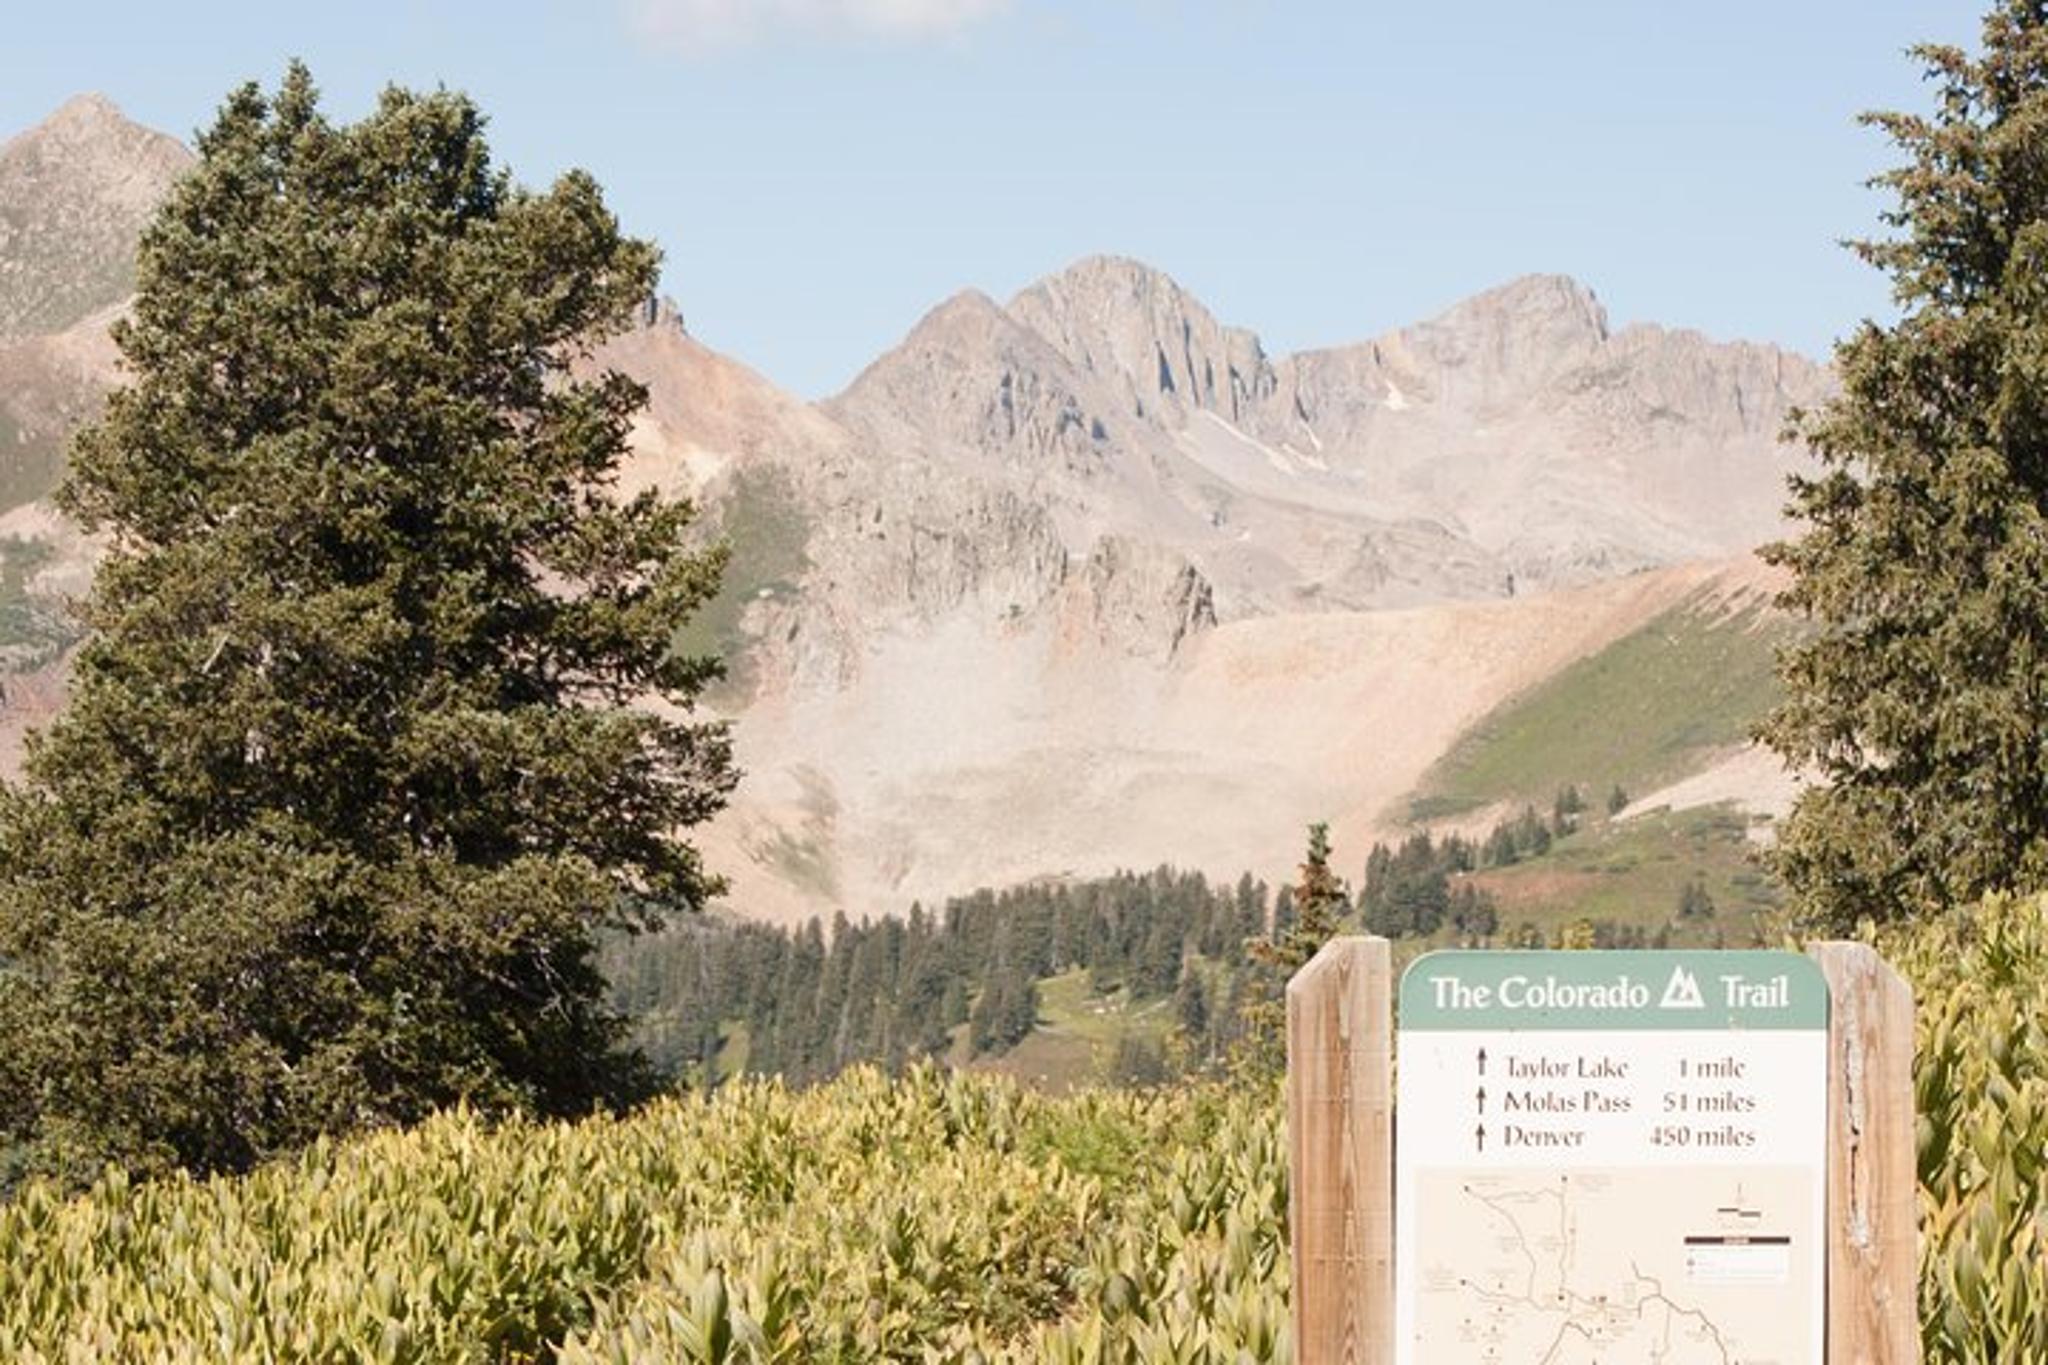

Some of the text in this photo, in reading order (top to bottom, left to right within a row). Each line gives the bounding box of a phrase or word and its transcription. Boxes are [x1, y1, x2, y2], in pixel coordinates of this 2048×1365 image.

[1430, 975, 1789, 1008] The Colorado Trail
[1507, 1055, 1746, 1079] Taylor Lake 1 mile
[1503, 1090, 1756, 1113] Molas Pass 51 miles
[1503, 1124, 1756, 1148] Denver 450 miles
